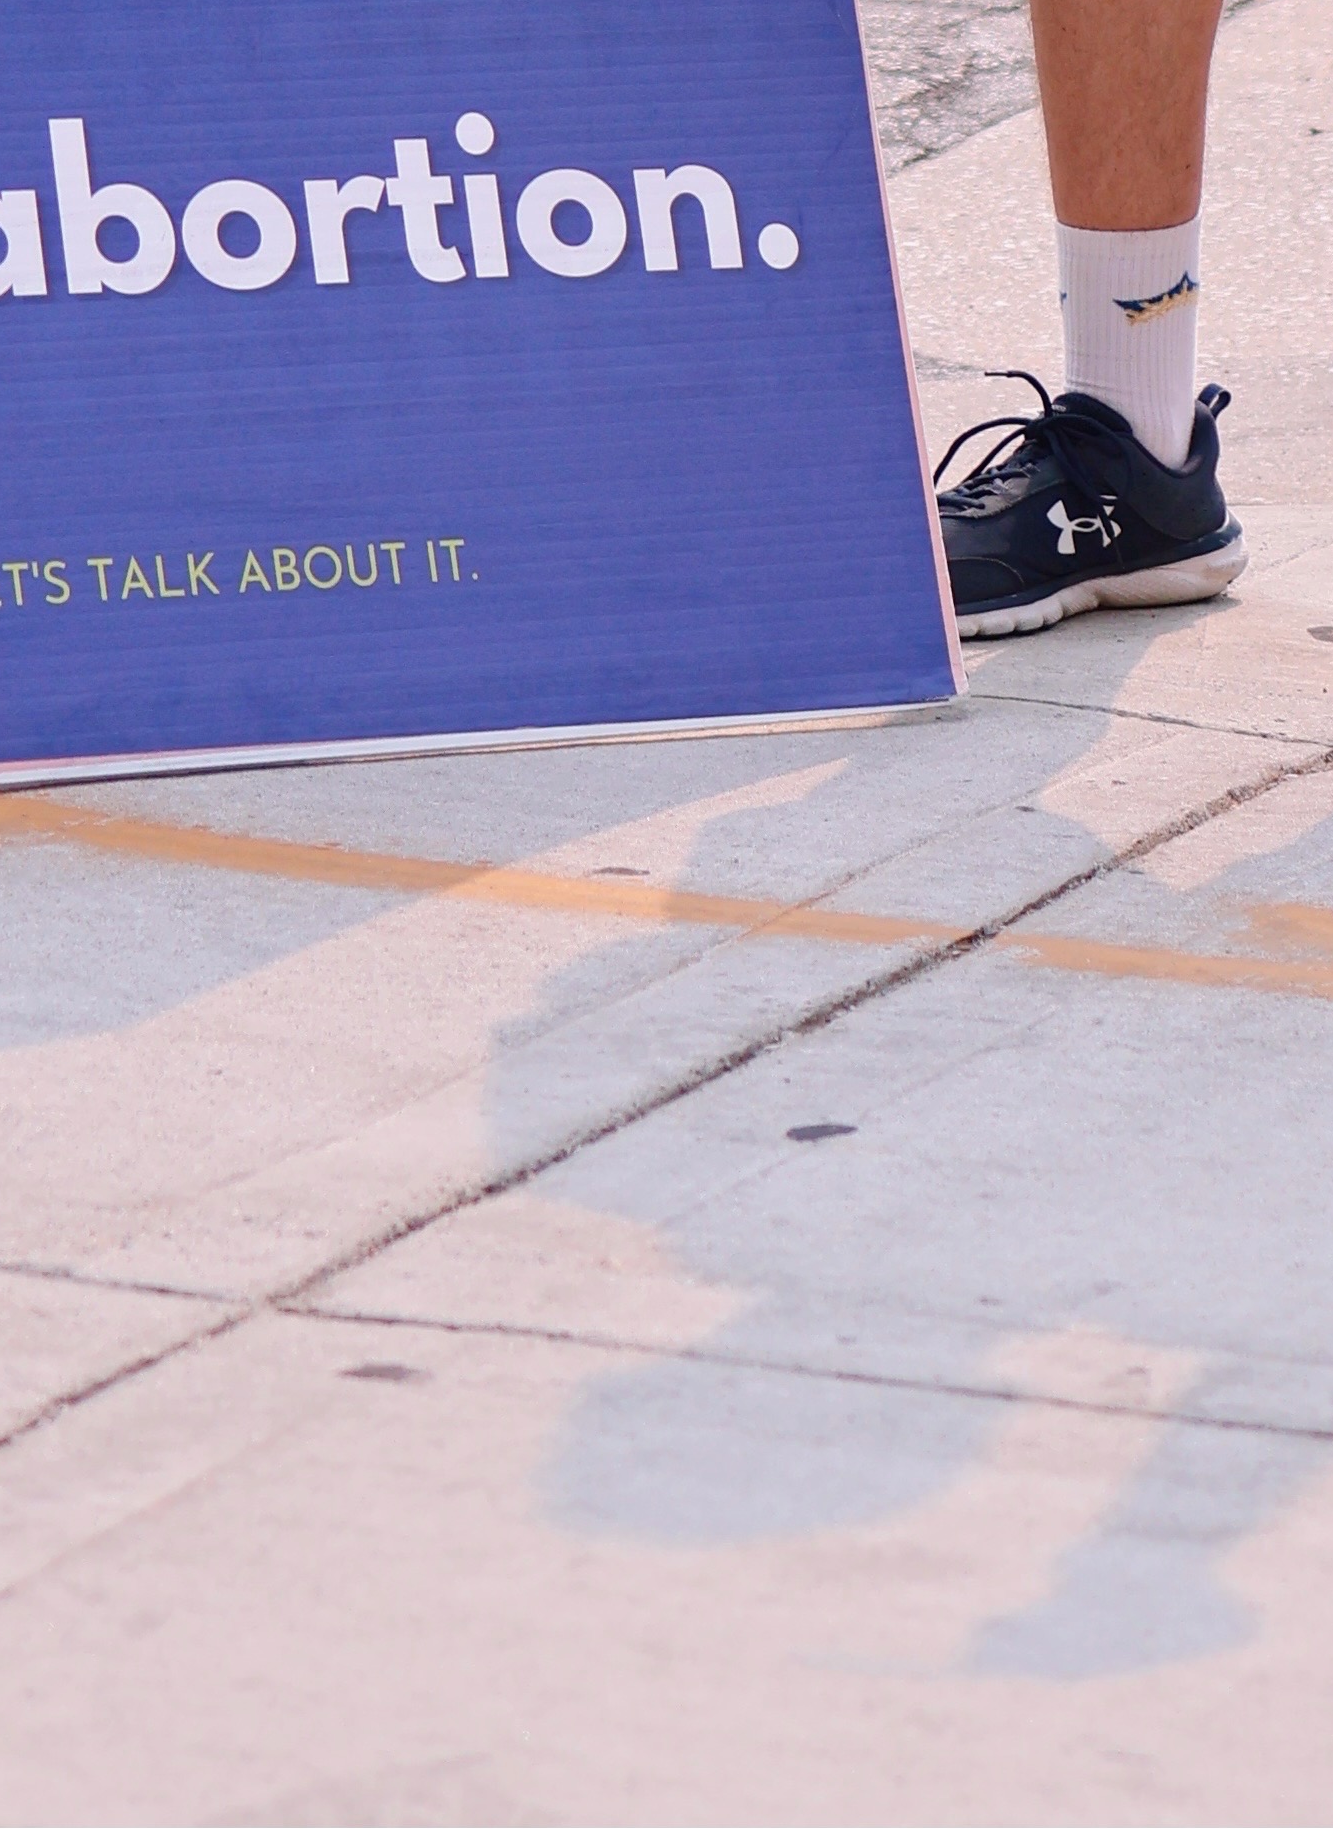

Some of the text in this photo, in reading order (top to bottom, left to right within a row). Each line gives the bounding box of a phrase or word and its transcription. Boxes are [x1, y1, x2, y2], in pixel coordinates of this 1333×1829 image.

[86, 553, 220, 602] TALK
[238, 543, 406, 594] ABOUT
[426, 538, 479, 583] IT.
